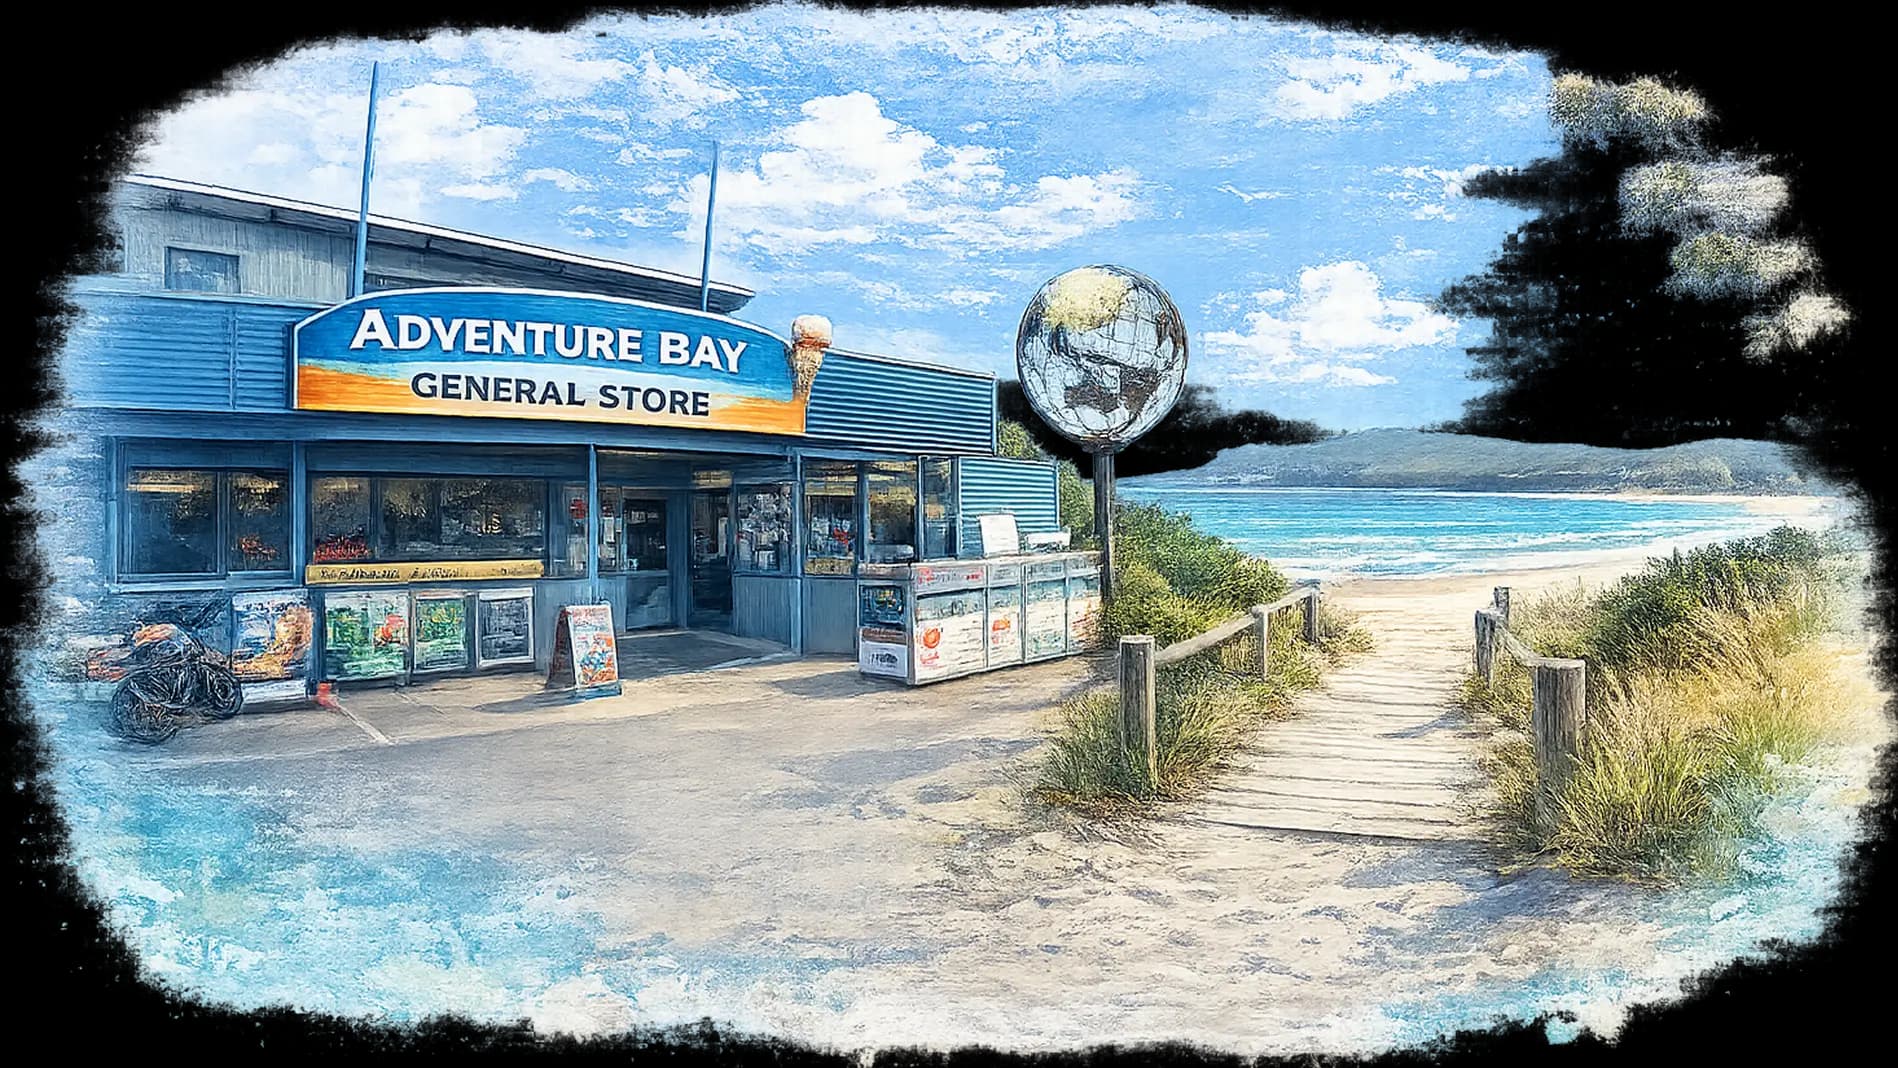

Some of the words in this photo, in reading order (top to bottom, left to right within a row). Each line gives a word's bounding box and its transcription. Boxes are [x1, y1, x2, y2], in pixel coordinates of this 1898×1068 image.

[350, 308, 642, 363] ADVENTURE
[658, 331, 748, 374] BAY
[411, 372, 586, 408] GENERAL
[598, 385, 710, 417] STORE
